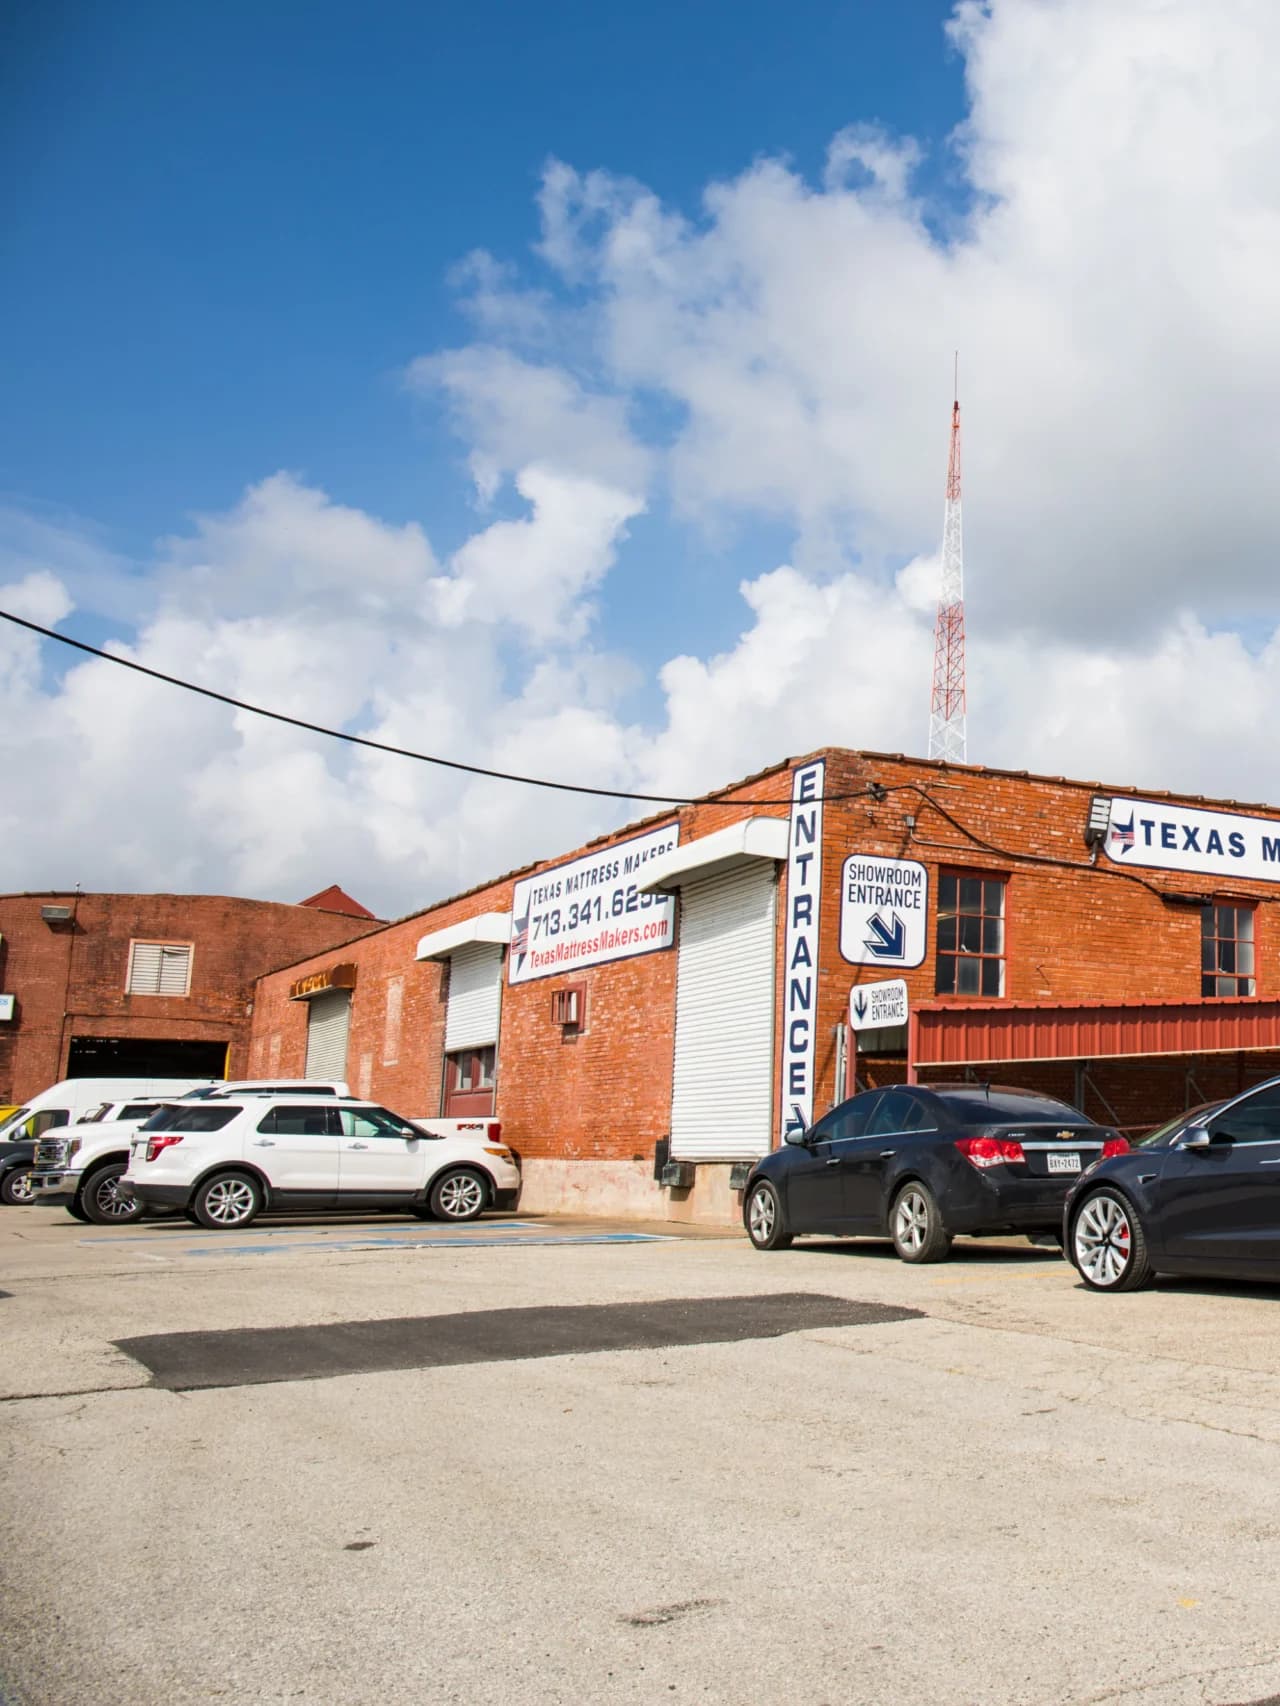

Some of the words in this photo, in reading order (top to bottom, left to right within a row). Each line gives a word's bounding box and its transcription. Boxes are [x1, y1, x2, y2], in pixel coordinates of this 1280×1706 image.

[1140, 819, 1246, 858] TEXAS
[533, 881, 562, 906] TEXAS
[566, 860, 620, 894] MATTRESS
[849, 863, 922, 887] SHOWROOM
[848, 884, 921, 909] ENTRANCE
[530, 919, 668, 969] TexasMattressMakers.com
[789, 770, 817, 1095] ENTRANCE
[871, 986, 904, 1004] SHOWROOM
[871, 1001, 905, 1021] ENTRANCE
